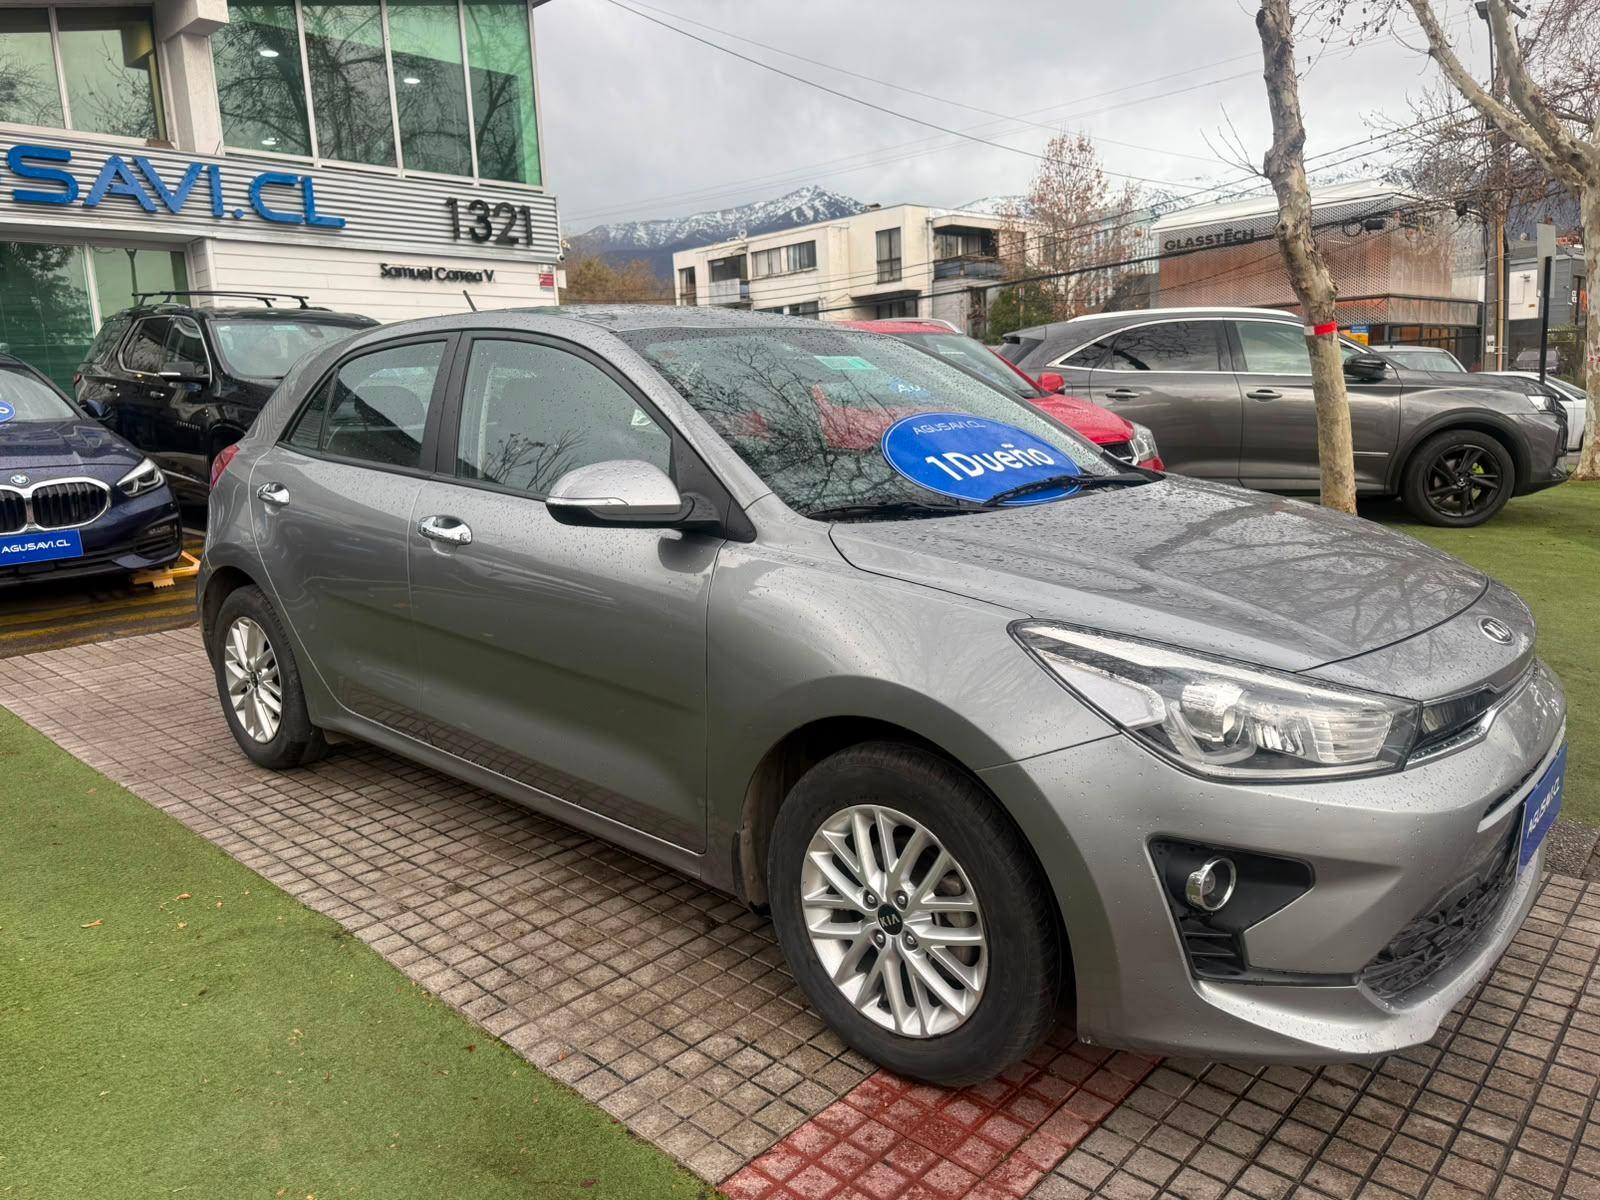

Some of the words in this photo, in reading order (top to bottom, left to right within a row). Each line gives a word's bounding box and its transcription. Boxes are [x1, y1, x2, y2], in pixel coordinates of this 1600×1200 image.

[6, 145, 346, 229] SAVI.CL
[444, 197, 534, 248] 1321
[380, 263, 433, 281] Samuel
[434, 267, 483, 283] Correa
[1, 539, 71, 554] AGUSAVI.CL
[880, 913, 901, 928] KIA
